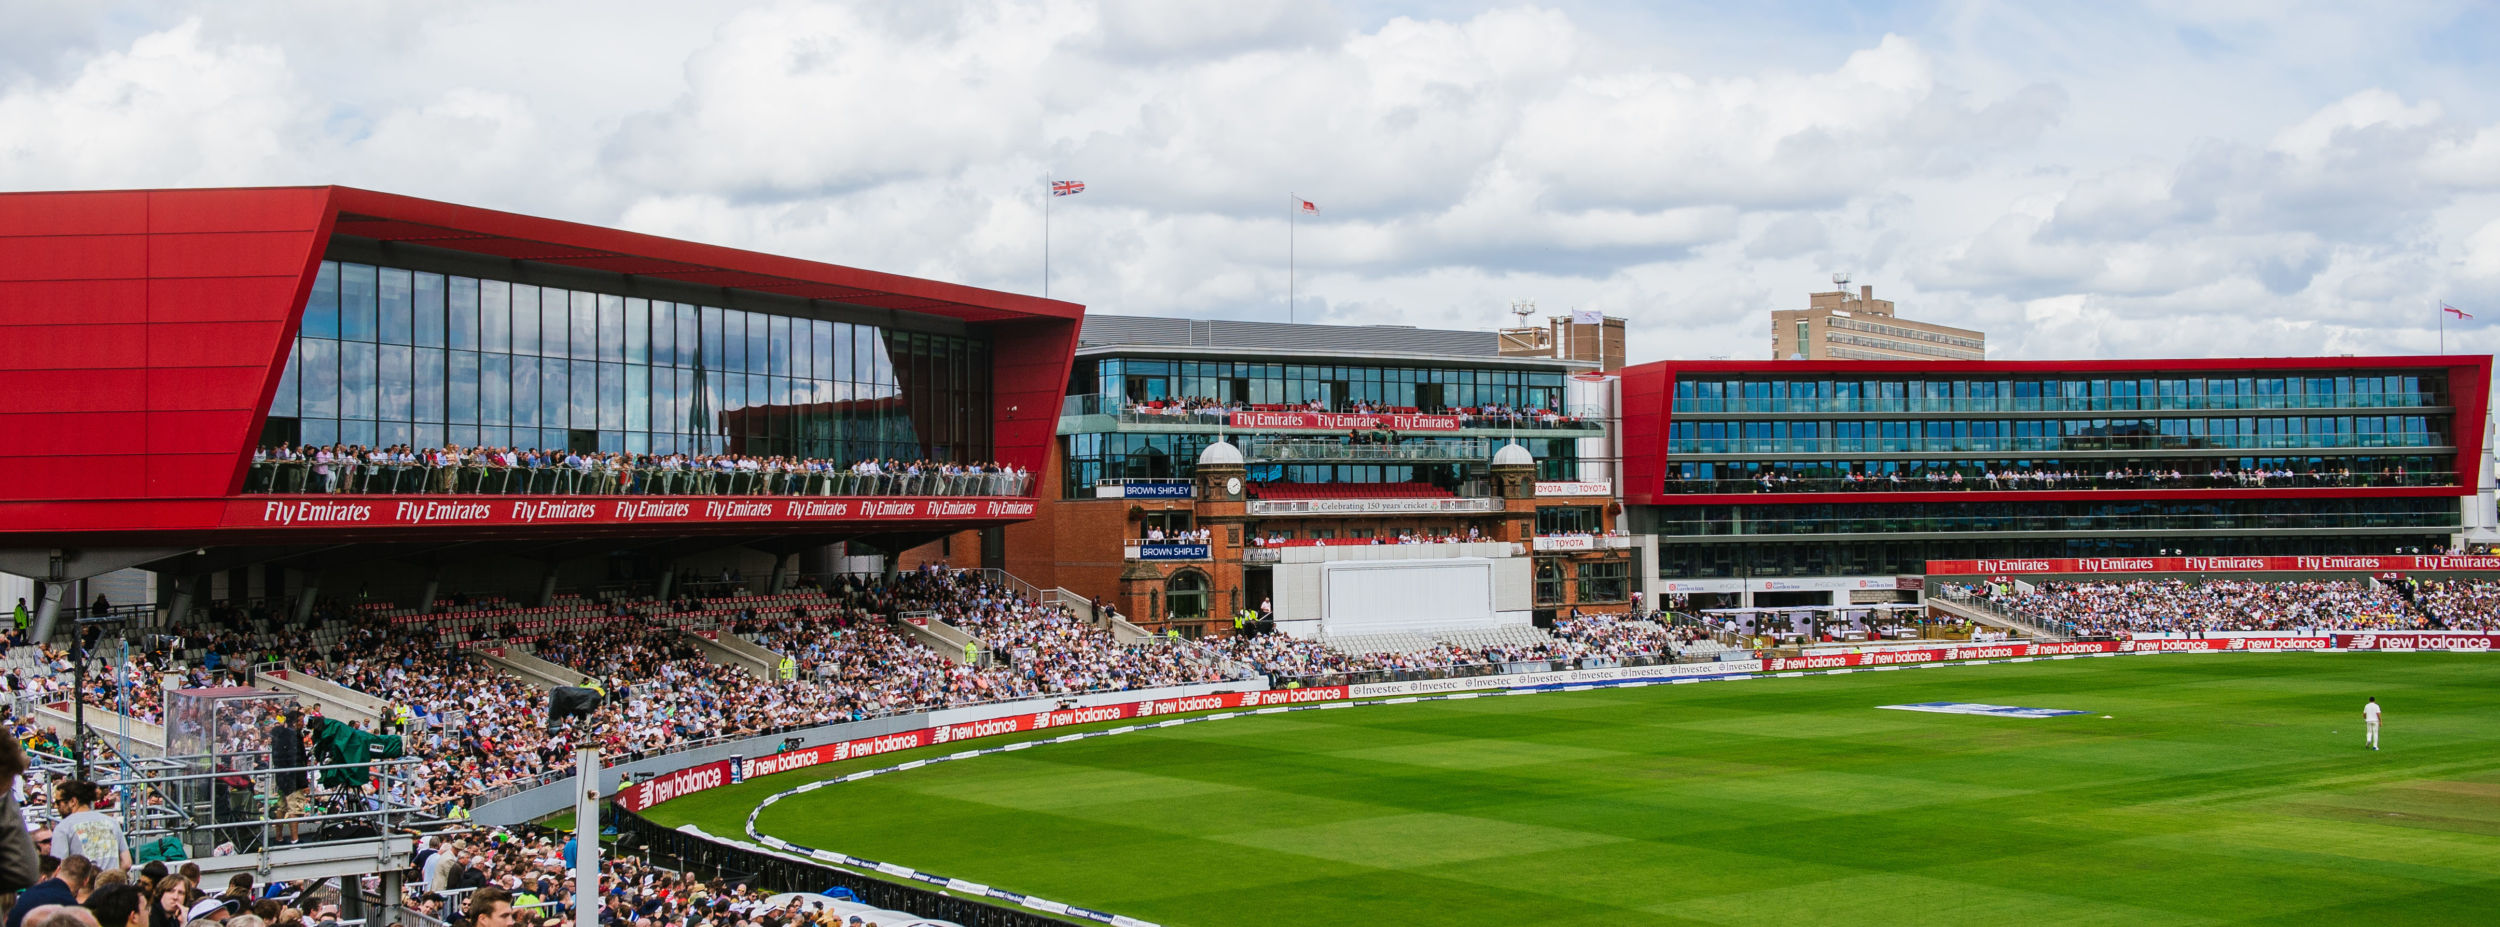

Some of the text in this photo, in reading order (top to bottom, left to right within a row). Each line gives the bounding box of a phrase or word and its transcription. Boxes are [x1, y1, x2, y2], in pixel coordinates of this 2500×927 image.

[1237, 413, 1303, 427] Fly Emirates
[1318, 414, 1381, 430] Fly Emirates
[1394, 416, 1454, 430] Fly Emirates
[1126, 486, 1190, 495] BROWN SHIPLEY
[264, 500, 372, 526] Fly Emirates
[396, 501, 490, 524] Fly Emirates
[512, 501, 596, 522] Fly Emirates
[615, 500, 690, 520] Fly Emirates
[705, 501, 772, 520] Fly Emirates
[786, 501, 848, 519] Fly Emirates
[860, 501, 915, 518] Fly Emirates
[926, 501, 976, 516] Fly Emirates
[987, 501, 1034, 516] Fly Emirates
[1321, 502, 1364, 512] Celebrating
[1404, 502, 1428, 510] cricket
[1142, 548, 1205, 556] BROWN SHIPLEY
[1978, 560, 2050, 572] Fly Emirates
[2079, 558, 2154, 572] Fly Emirates
[2185, 558, 2264, 570] Fly Emirates
[2298, 556, 2380, 570] Fly Emirates
[2415, 556, 2500, 568] Fly Emirates
[2040, 645, 2060, 654] new
[2062, 642, 2102, 654] balance
[2137, 642, 2160, 650] new
[2161, 639, 2209, 650] balance
[2247, 640, 2272, 649] new
[2274, 638, 2326, 649] balance
[2380, 637, 2414, 649] new
[2418, 635, 2492, 649] balance
[1876, 654, 1894, 664] new
[1896, 650, 1932, 663] balance
[1960, 648, 1976, 659] new
[1978, 646, 2012, 658] balance
[1678, 664, 1712, 674] Investec
[1726, 662, 1760, 671] Investec
[1786, 660, 1806, 669] new
[1808, 657, 1846, 668] balance
[1527, 672, 1564, 684] Investec
[1578, 670, 1614, 680] Investec
[1629, 668, 1664, 678] Investec
[1362, 684, 1402, 694] Investec
[1419, 681, 1458, 692] Investec
[1474, 677, 1512, 687] Investec
[1262, 692, 1288, 704] new
[1290, 688, 1341, 702] balance
[1156, 702, 1178, 714] new
[1178, 696, 1222, 712] balance
[1052, 713, 1074, 726] new
[1075, 706, 1120, 724] balance
[952, 727, 974, 740] new
[975, 719, 1017, 738] balance
[851, 743, 873, 758] new
[874, 734, 918, 754] balance
[756, 758, 777, 776] new
[778, 750, 818, 772] balance
[656, 781, 676, 804] new
[675, 768, 722, 795] balance
